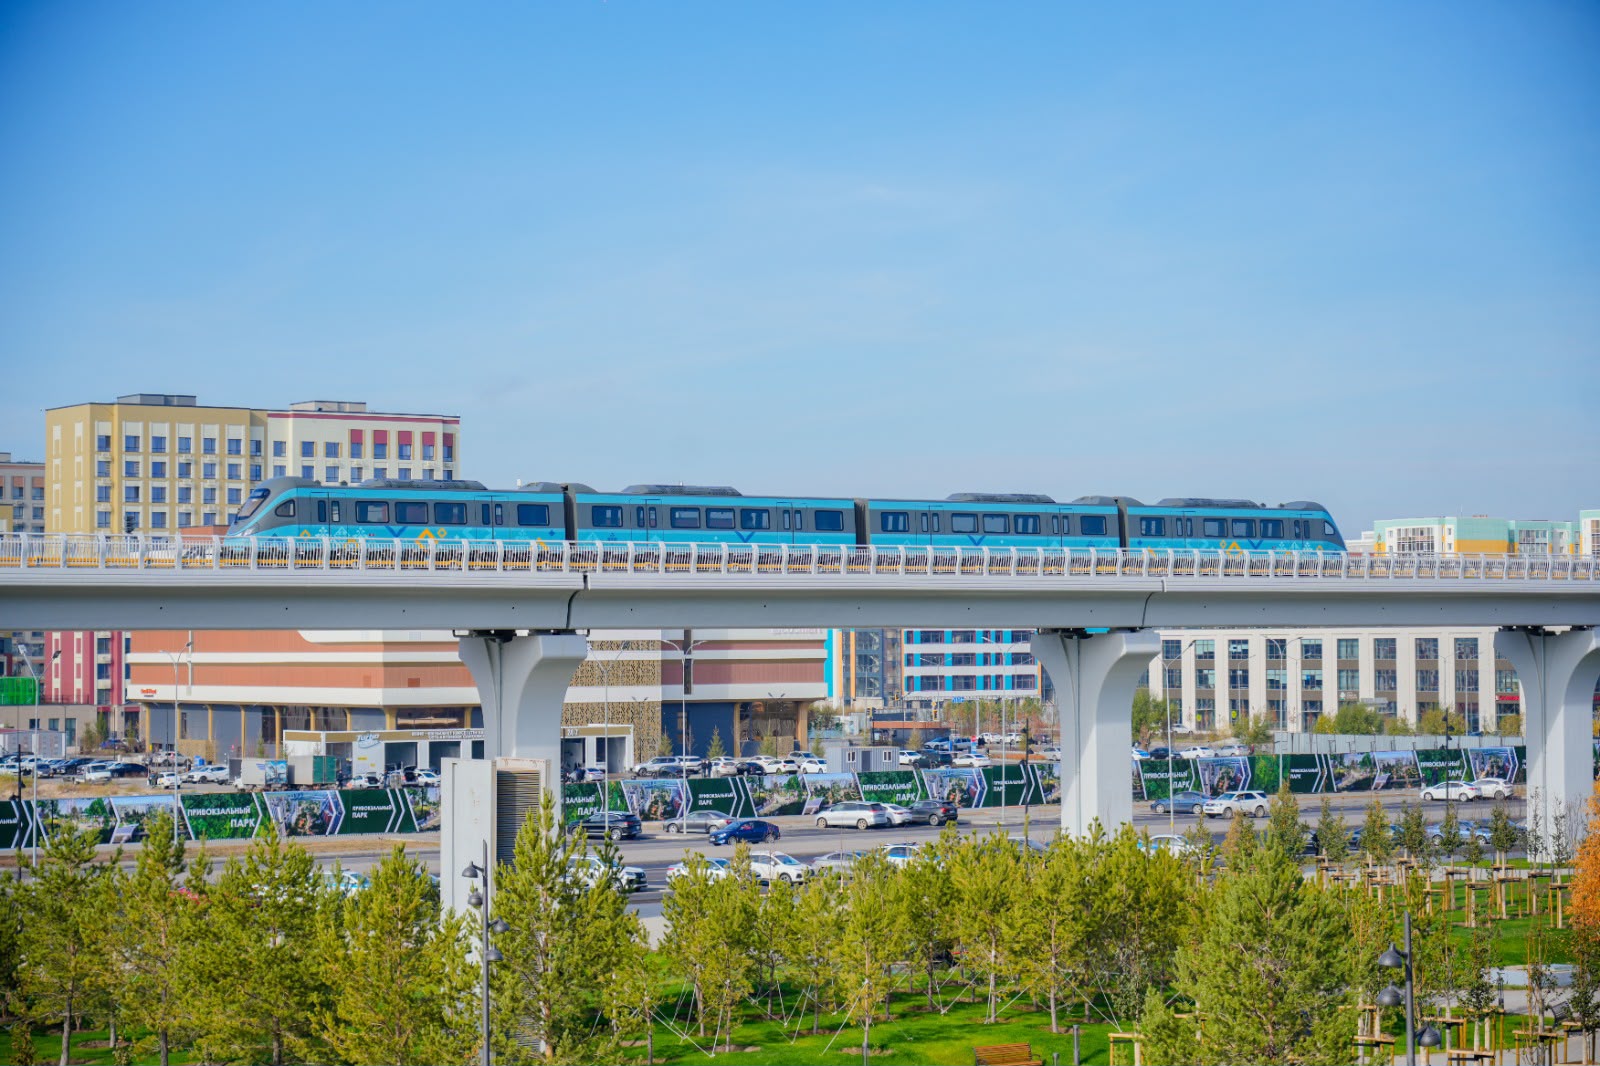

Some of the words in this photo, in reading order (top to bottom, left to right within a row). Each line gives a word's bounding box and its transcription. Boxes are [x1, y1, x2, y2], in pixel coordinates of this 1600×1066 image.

[862, 782, 912, 791] ПРИВОКЗАЛЬНЫЙ
[1173, 781, 1191, 789] ПАРК
[896, 793, 917, 801] ПАРК
[187, 806, 251, 816] ПРИВОКЗАЛЬНЫЙ
[231, 818, 256, 828] ПАРК
